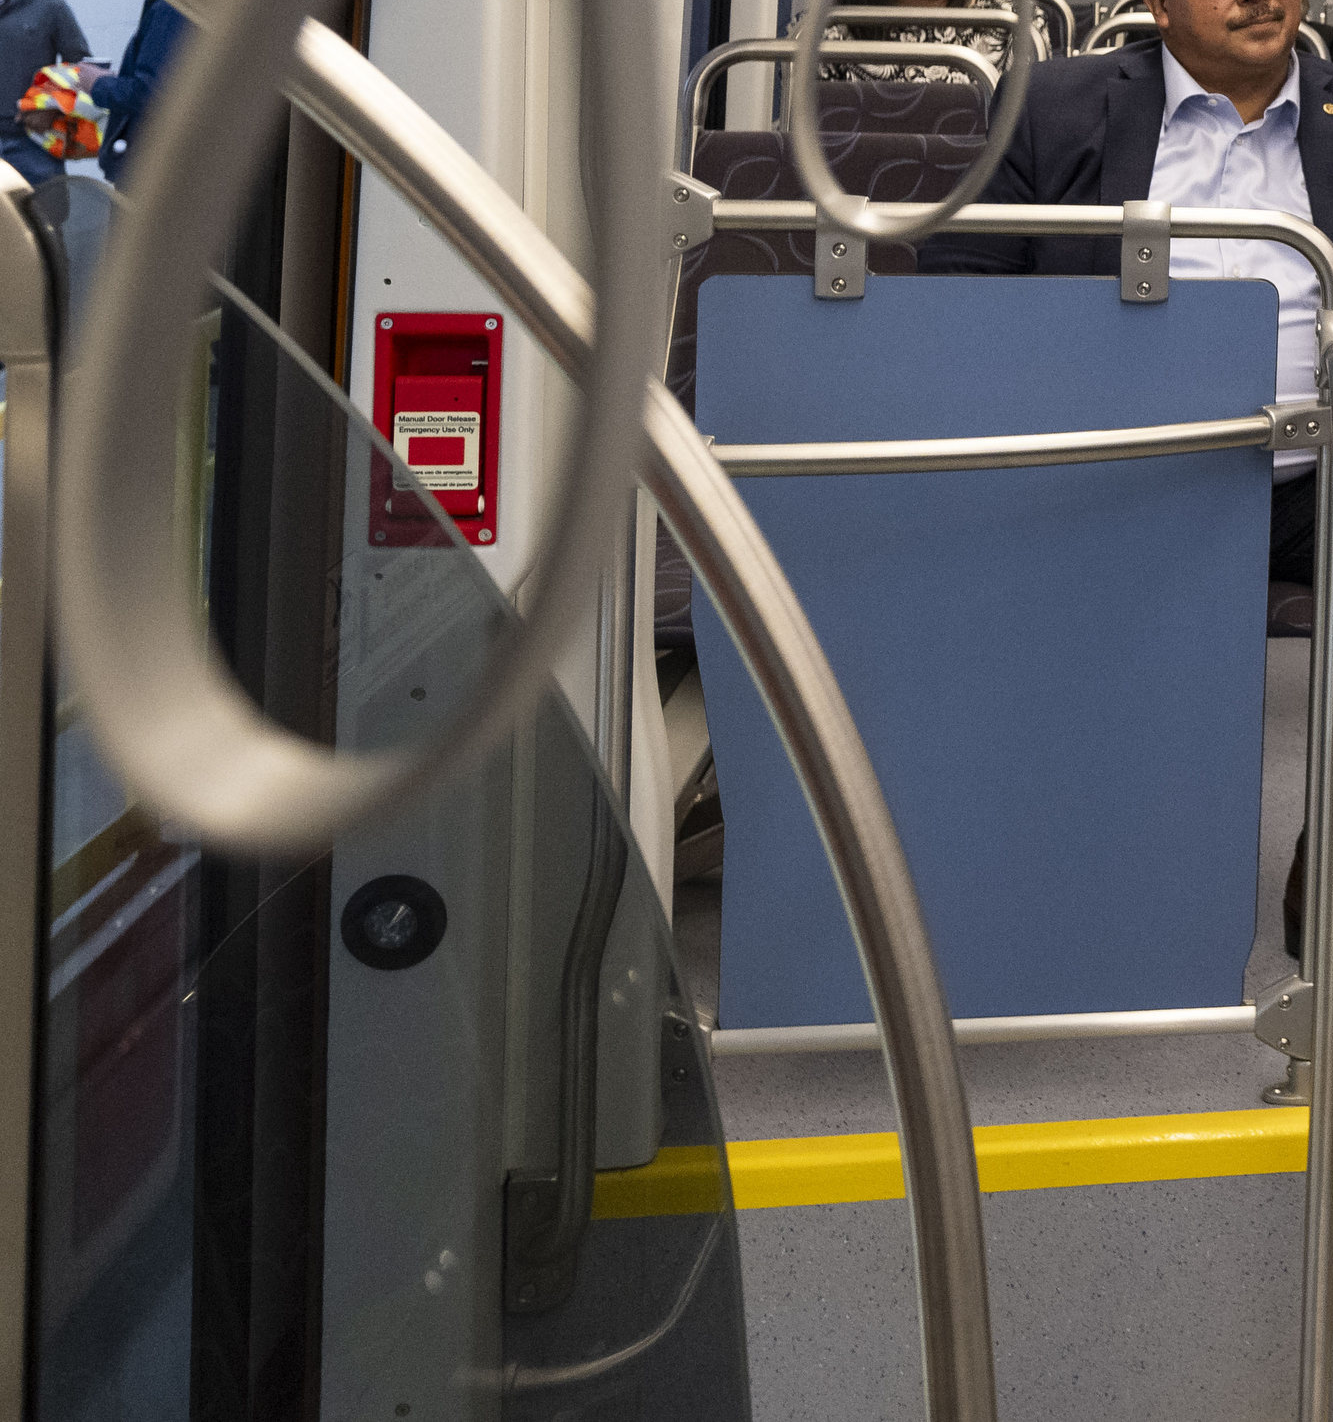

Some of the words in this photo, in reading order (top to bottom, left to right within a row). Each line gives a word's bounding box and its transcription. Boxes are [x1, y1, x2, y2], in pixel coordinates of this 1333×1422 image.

[399, 426, 440, 435] Emergency
[442, 426, 456, 434] Use
[458, 426, 475, 435] Only
